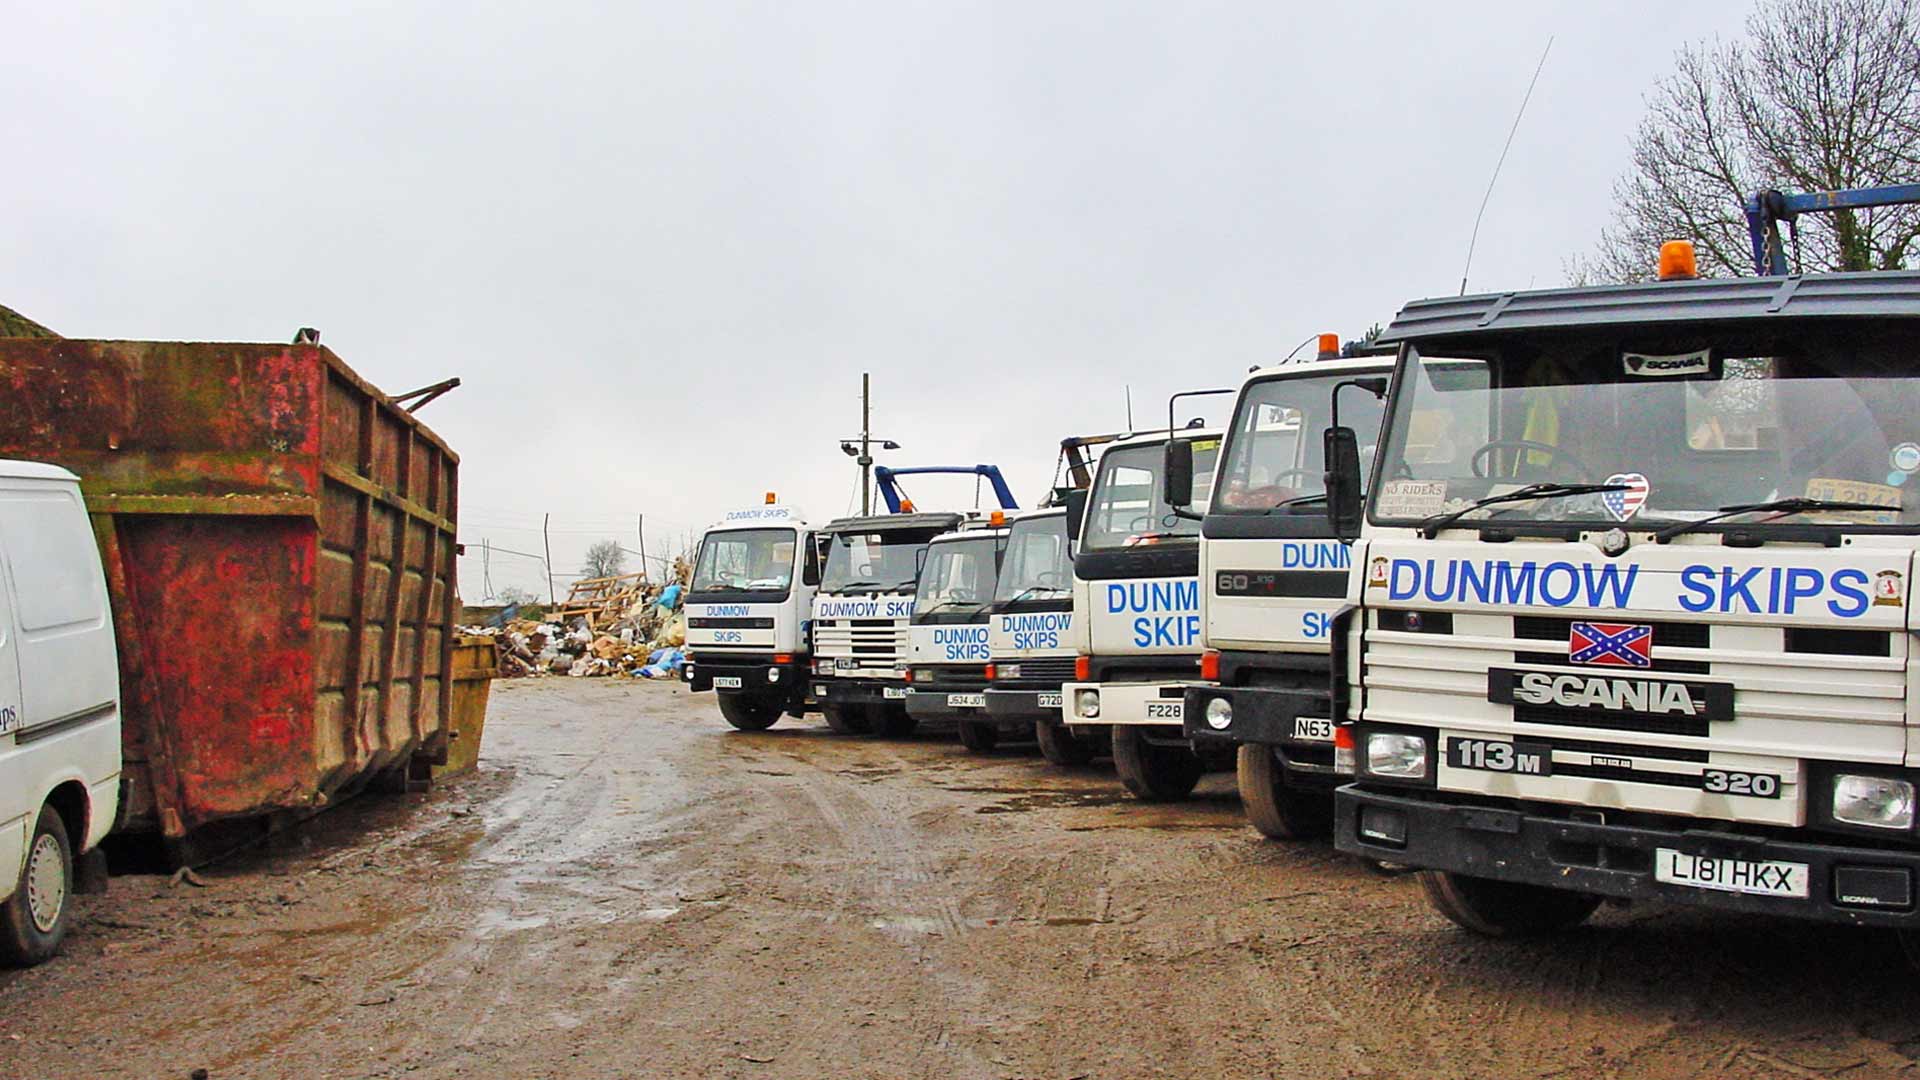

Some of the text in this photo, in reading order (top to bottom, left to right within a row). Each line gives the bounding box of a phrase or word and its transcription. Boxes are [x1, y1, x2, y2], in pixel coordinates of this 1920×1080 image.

[1645, 356, 1705, 369] SCANIA
[1384, 484, 1443, 496] NO RIDERS
[1389, 559, 1869, 618] DUNMOW SKIPS
[706, 605, 750, 616] DUNMOW
[820, 602, 878, 617] DUNMOW
[1002, 614, 1072, 633] DUNMOW
[714, 631, 742, 642] SKIPS
[934, 628, 990, 644] DUNMO
[1014, 632, 1058, 649] SKIPS
[946, 644, 990, 660] SKIPS
[1518, 672, 1698, 716] SCANIA
[0, 705, 16, 731] ps
[1148, 704, 1181, 718] F228
[1297, 720, 1331, 737] N63
[1457, 739, 1541, 774] 113 M
[1704, 770, 1775, 796] 320
[1672, 854, 1723, 883] L181
[1732, 860, 1792, 891] HKX
